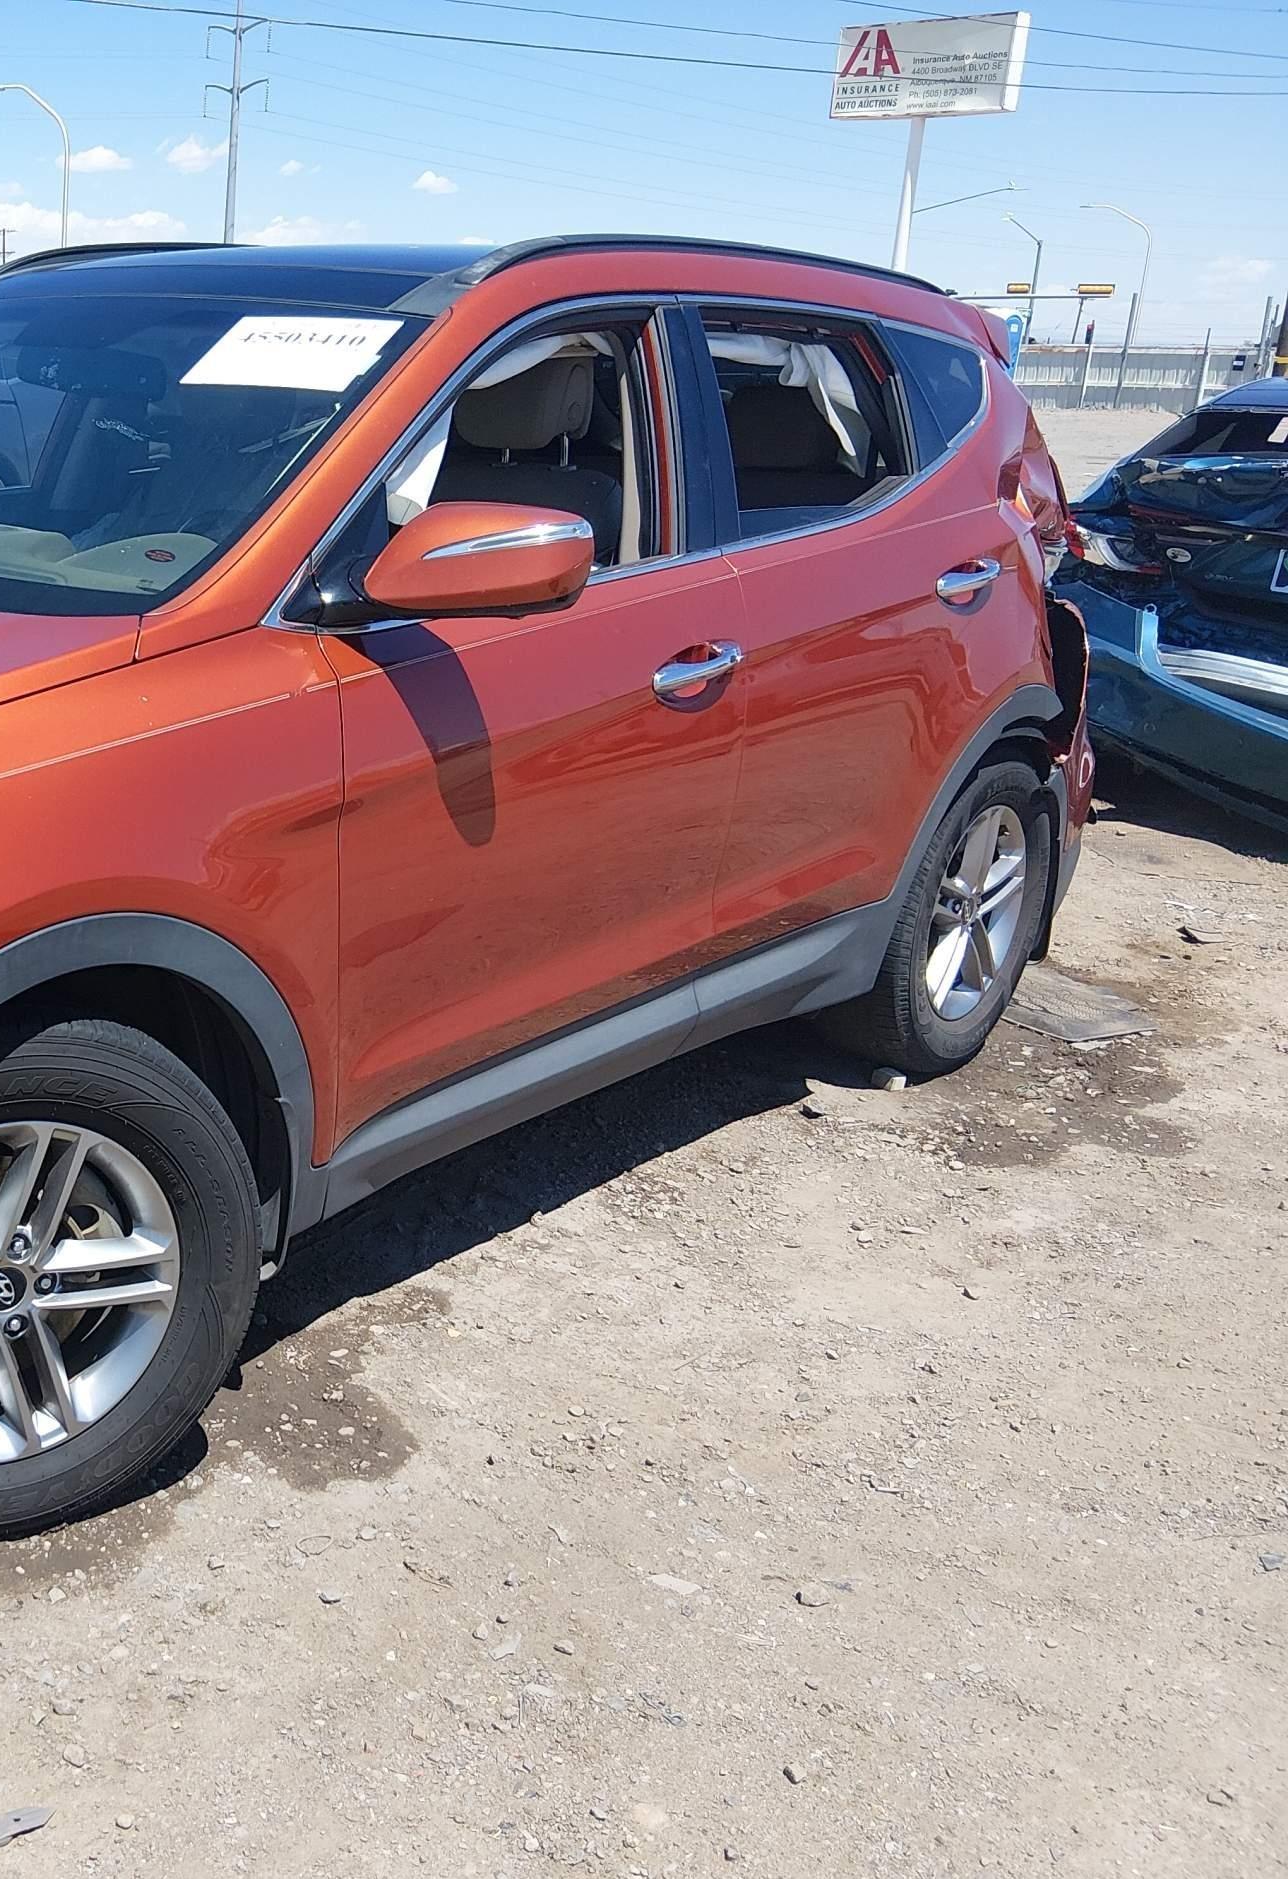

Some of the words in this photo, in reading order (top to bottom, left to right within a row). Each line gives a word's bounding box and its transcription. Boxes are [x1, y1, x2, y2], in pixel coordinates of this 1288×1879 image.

[912, 54, 952, 65] Insurance
[952, 53, 971, 62] Auto
[972, 50, 1009, 60] Auctions
[912, 67, 930, 75] 4400
[931, 64, 967, 75] Broadway
[968, 62, 990, 72] BLVD
[991, 62, 1004, 70] SE
[959, 75, 973, 83] NM
[974, 73, 998, 82] 87105
[836, 83, 901, 96] INSURANCE
[922, 89, 943, 100] (505)
[943, 87, 979, 97] 873-2081
[834, 100, 857, 110] AUTO
[857, 98, 898, 109] AUCTIONS
